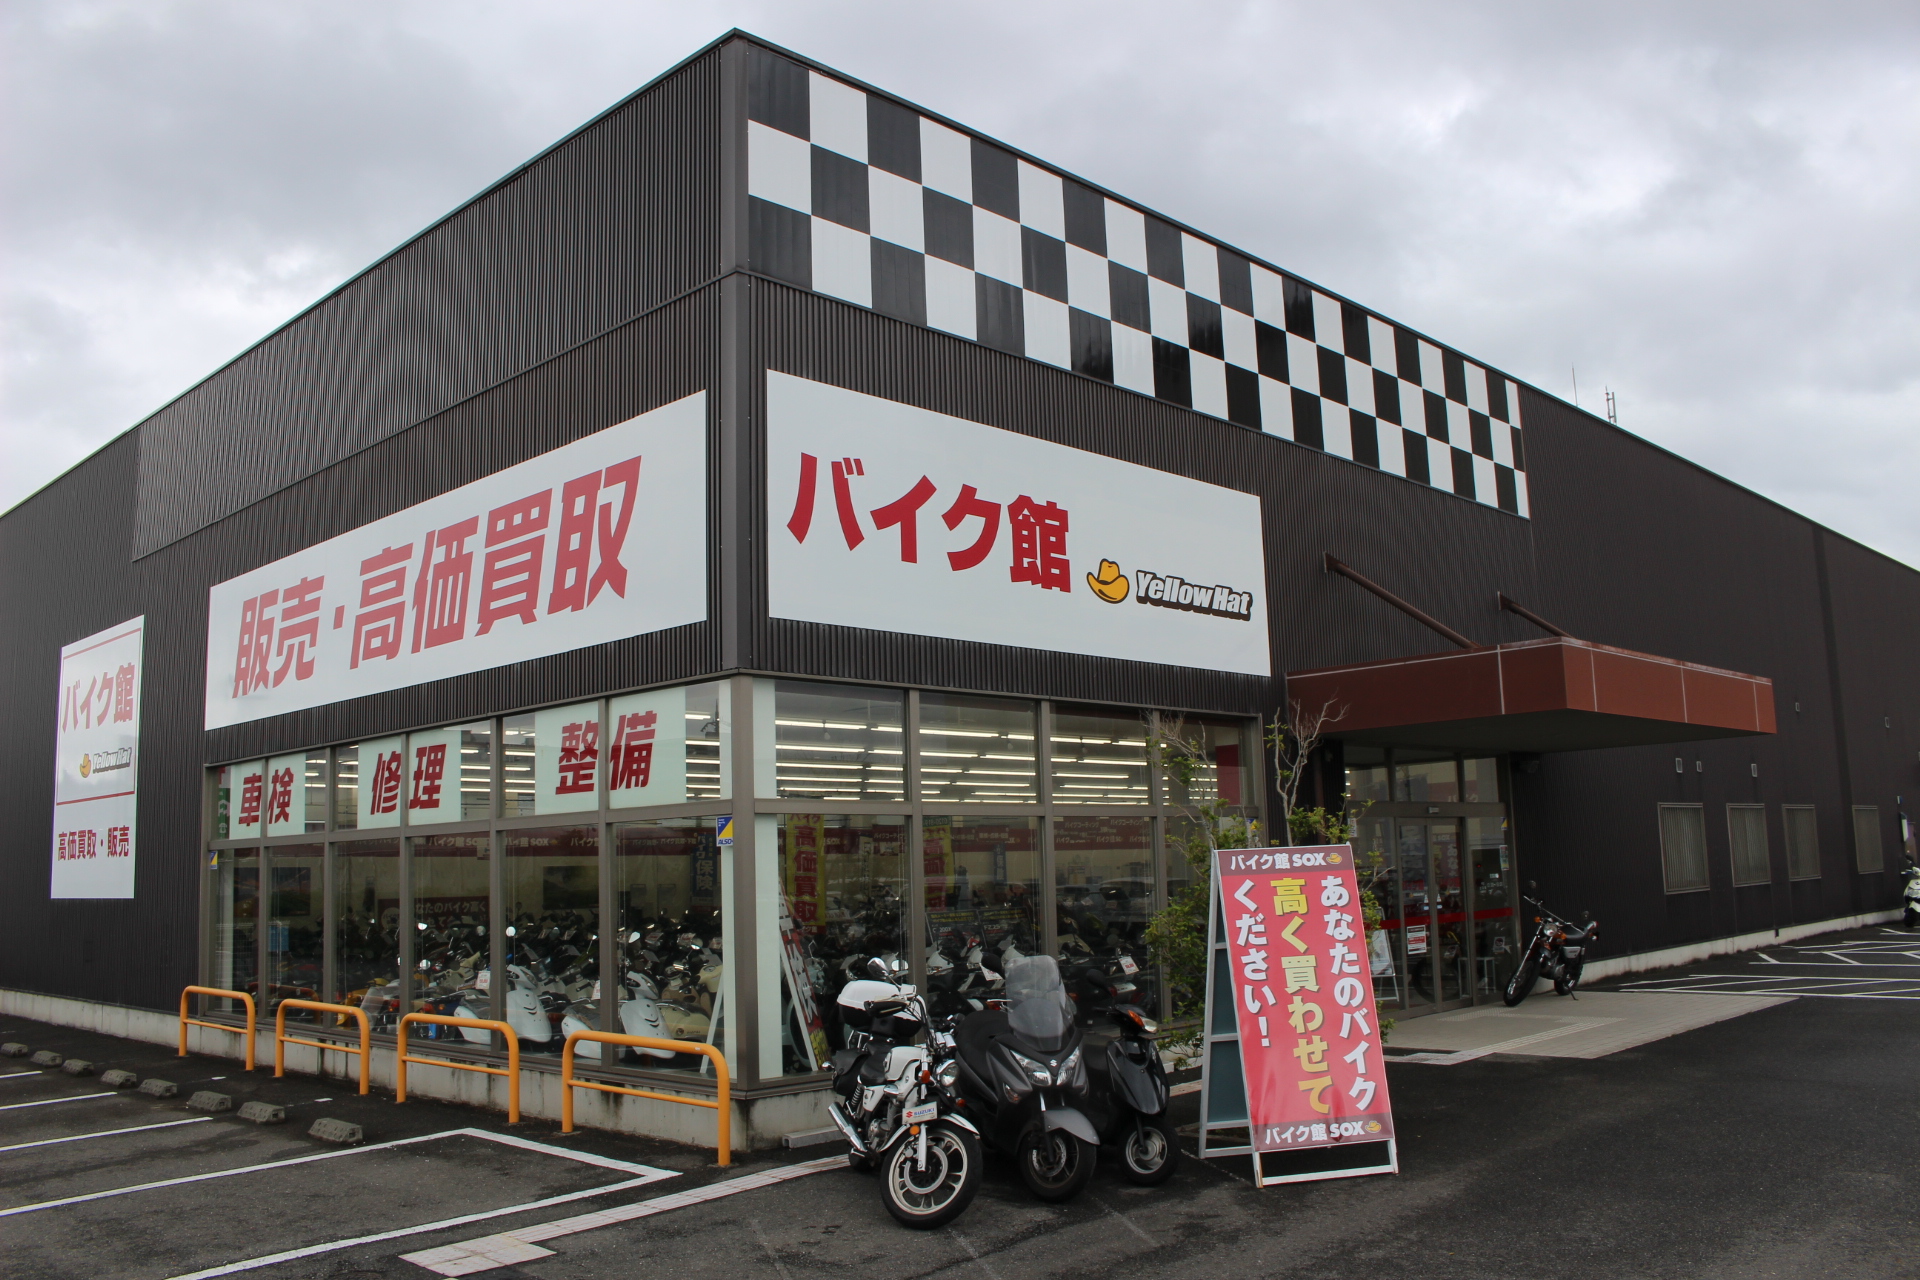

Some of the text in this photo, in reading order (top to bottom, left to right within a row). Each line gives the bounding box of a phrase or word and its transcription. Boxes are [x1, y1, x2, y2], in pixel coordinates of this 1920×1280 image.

[787, 452, 1072, 593] バイク館
[62, 662, 136, 733] バイク館
[370, 743, 447, 816] 修理
[555, 709, 658, 796] 整備
[238, 766, 296, 827] 車検
[1230, 852, 1328, 871] バイク館 SOX
[1270, 877, 1334, 1114] 高く買わせて
[1320, 875, 1377, 1112] あなたのバイク
[1265, 1120, 1366, 1146] バイク館 SOX
